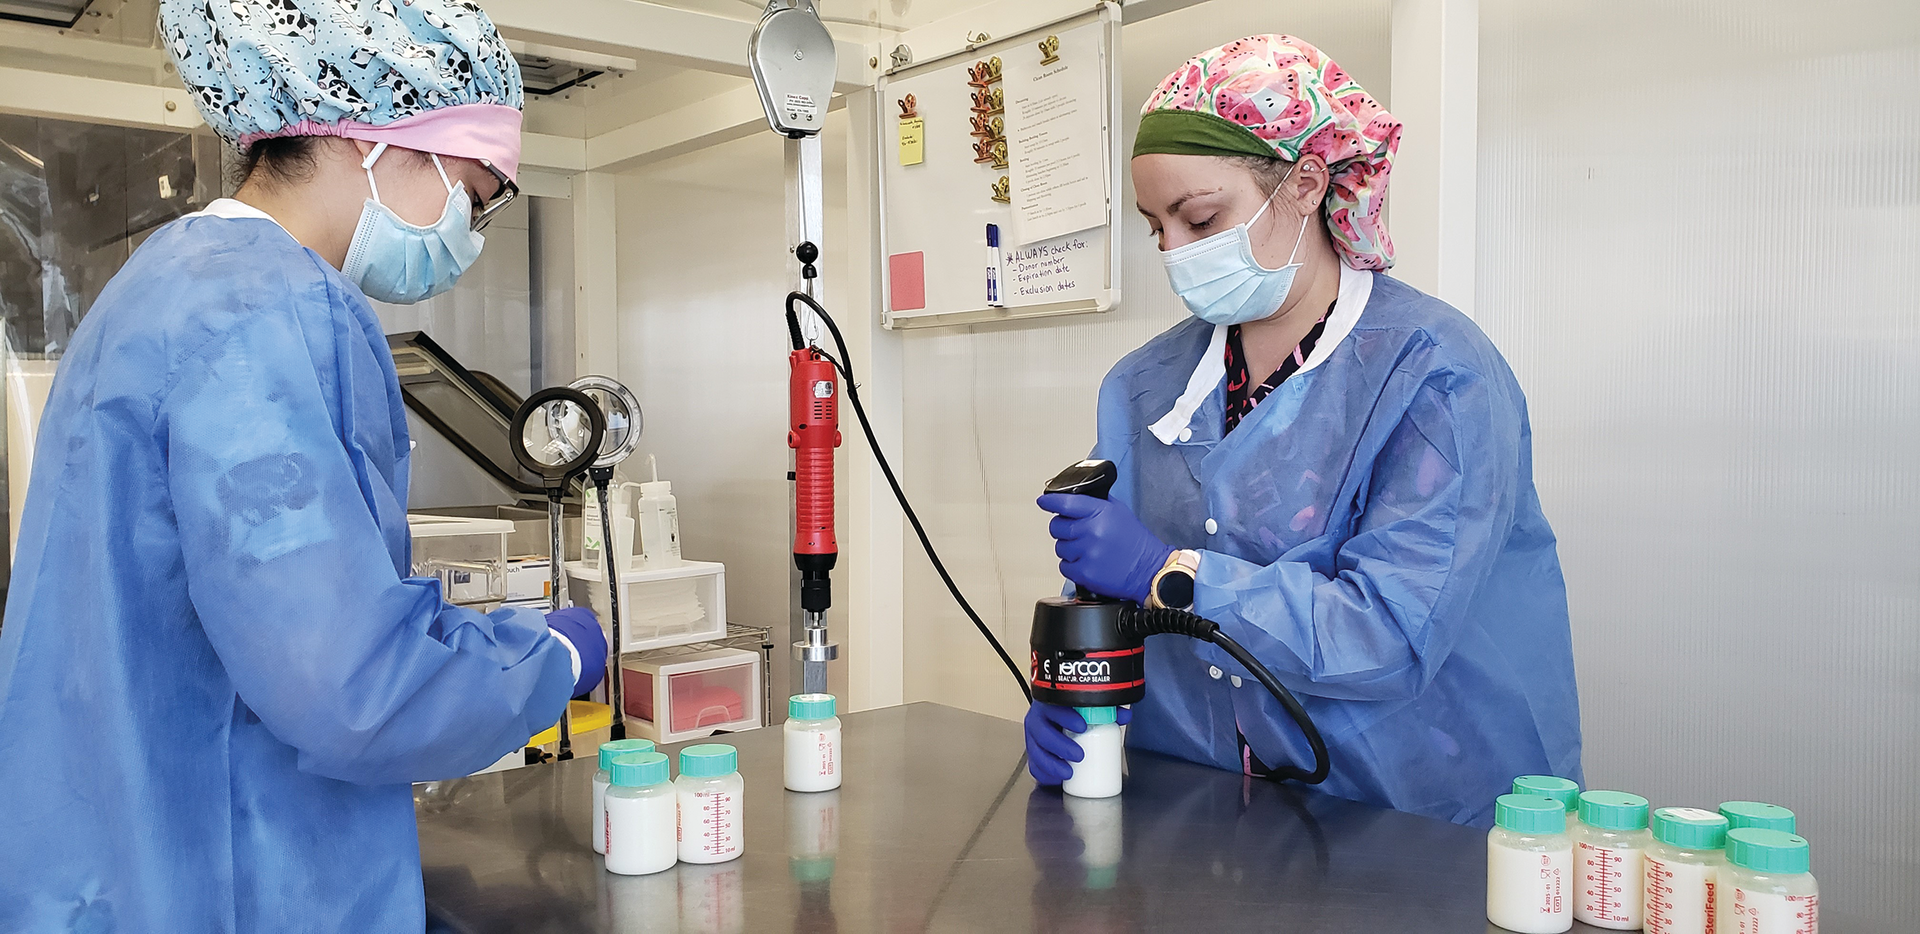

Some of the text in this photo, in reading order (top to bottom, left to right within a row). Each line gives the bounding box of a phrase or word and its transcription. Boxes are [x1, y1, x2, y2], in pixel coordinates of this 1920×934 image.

[1015, 245, 1049, 263] ALWAYS
[1051, 241, 1072, 255] check
[1018, 263, 1038, 273] Donor
[1041, 256, 1065, 268] number
[1018, 269, 1053, 283] Expiration
[1055, 263, 1071, 274] date
[1020, 284, 1053, 296] Exclusion
[1057, 279, 1076, 292] dates
[1704, 882, 1714, 934] SteriFeed
